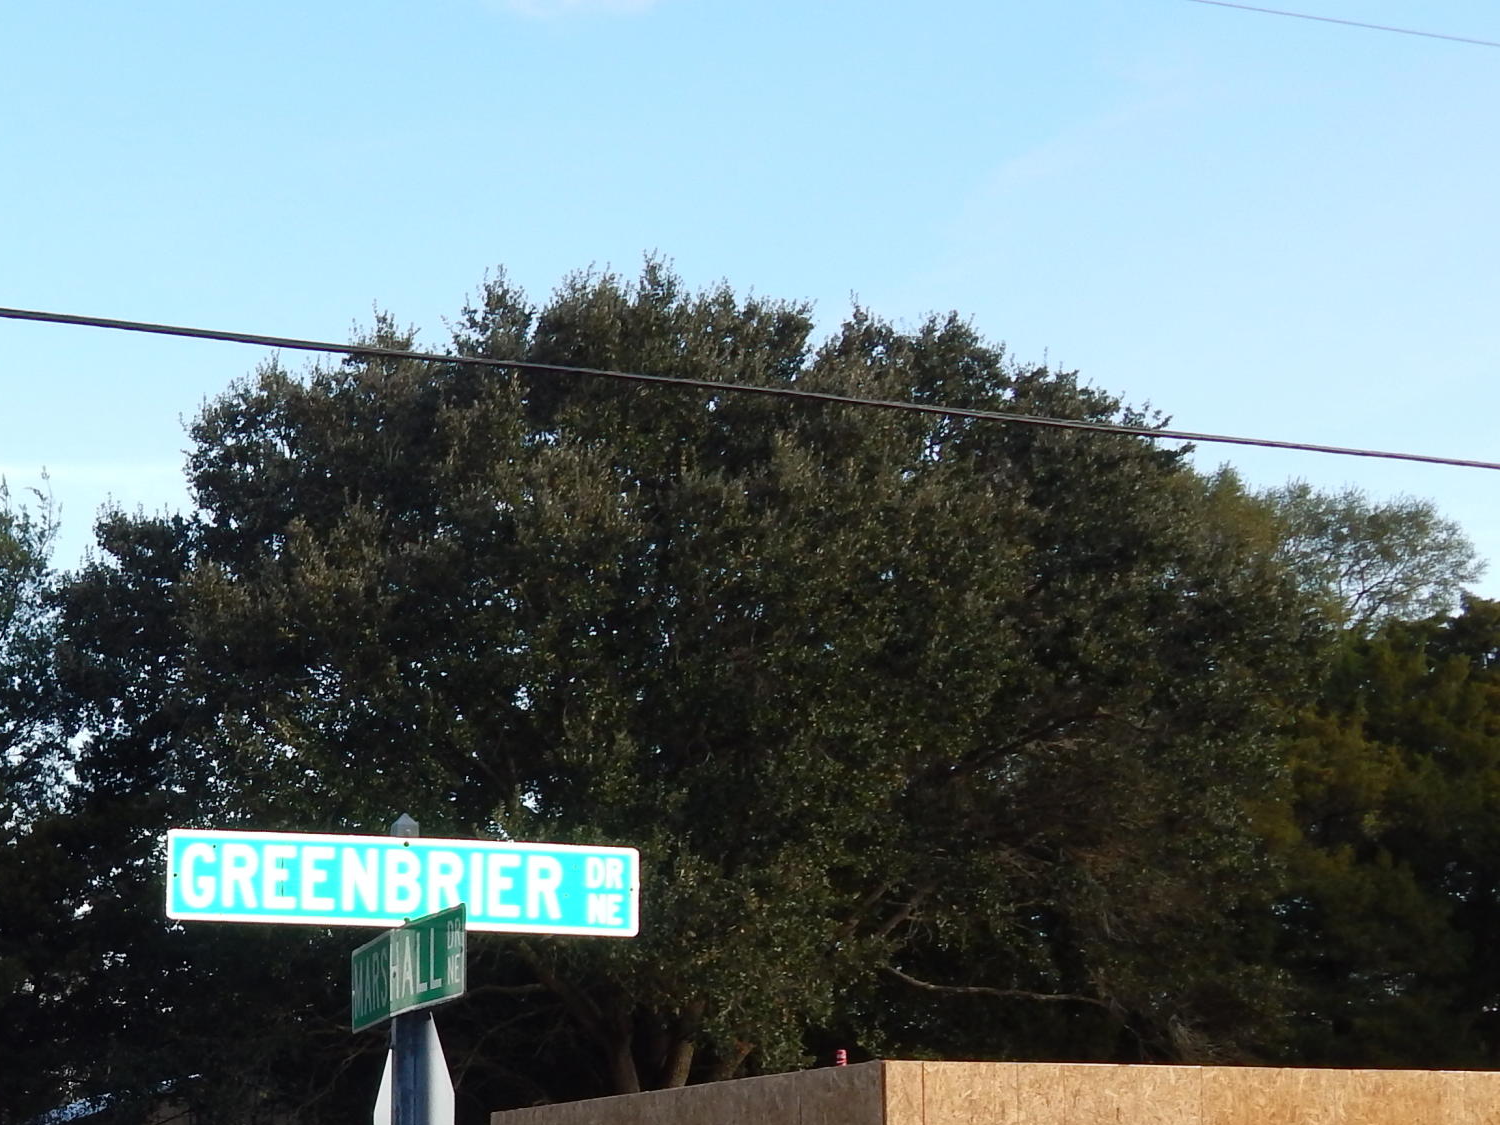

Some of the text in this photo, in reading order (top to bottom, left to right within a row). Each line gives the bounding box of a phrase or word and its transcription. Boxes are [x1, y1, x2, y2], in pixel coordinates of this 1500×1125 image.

[180, 843, 562, 919] GREENBRIER
[586, 857, 624, 889] DR
[587, 894, 623, 926] NE
[447, 919, 464, 949] DR
[354, 928, 442, 1019] MARSHALL
[447, 954, 461, 985] NE
